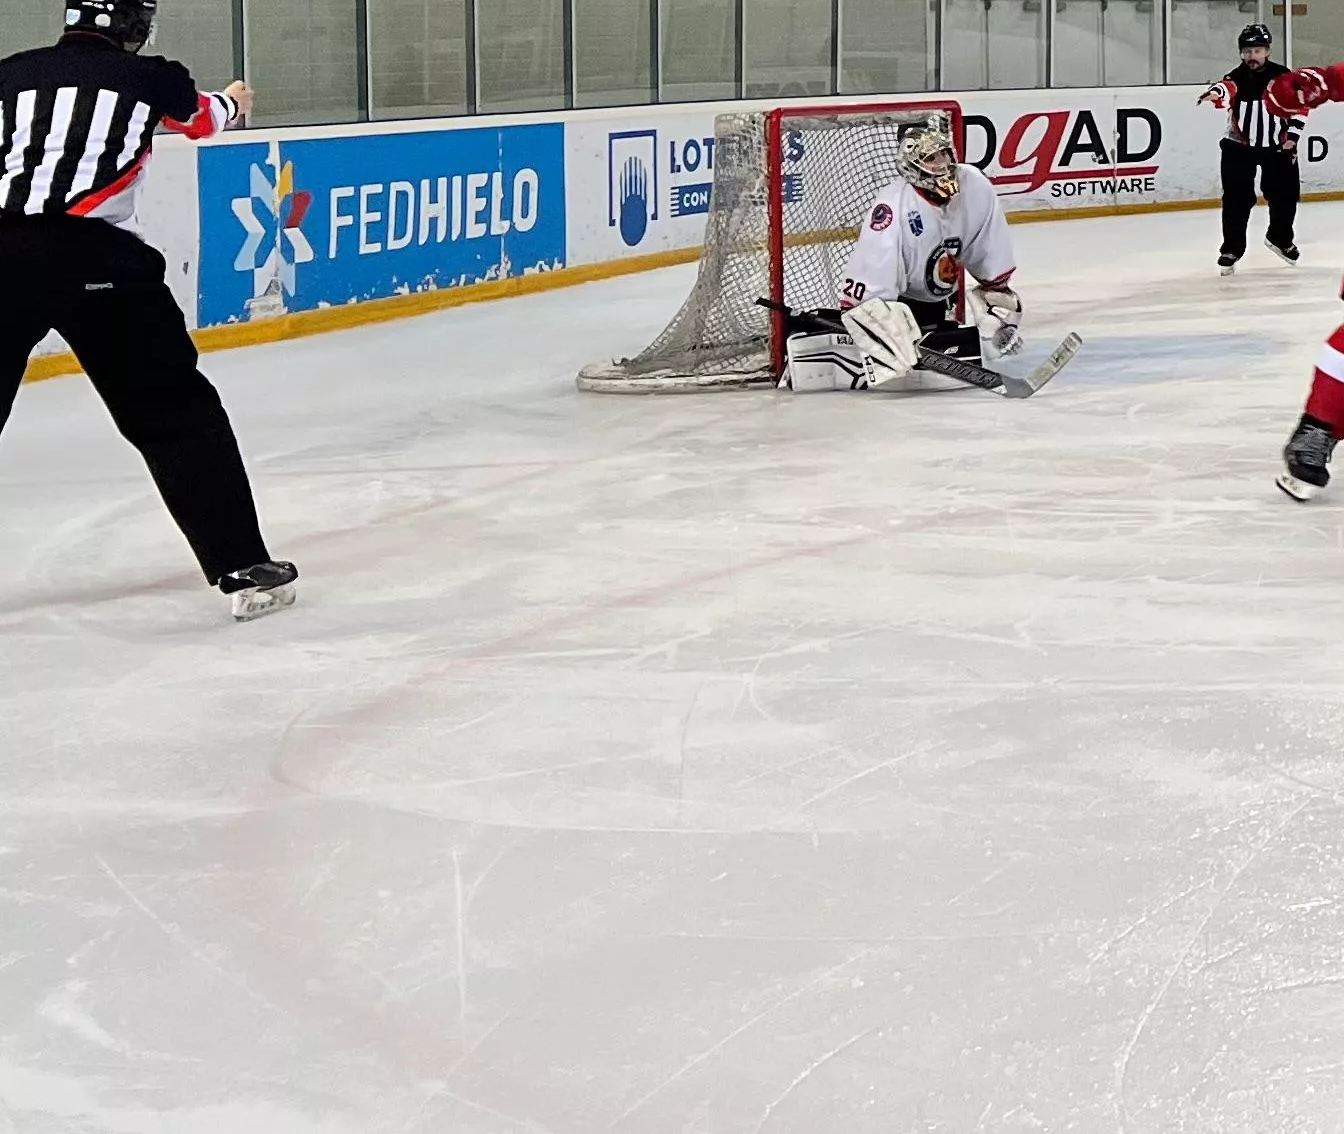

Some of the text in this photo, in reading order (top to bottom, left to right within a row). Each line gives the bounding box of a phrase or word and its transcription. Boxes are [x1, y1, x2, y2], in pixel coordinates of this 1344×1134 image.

[1050, 177, 1156, 198] SOFTWARE
[327, 167, 539, 259] FEDHIELO
[842, 278, 866, 302] 20
